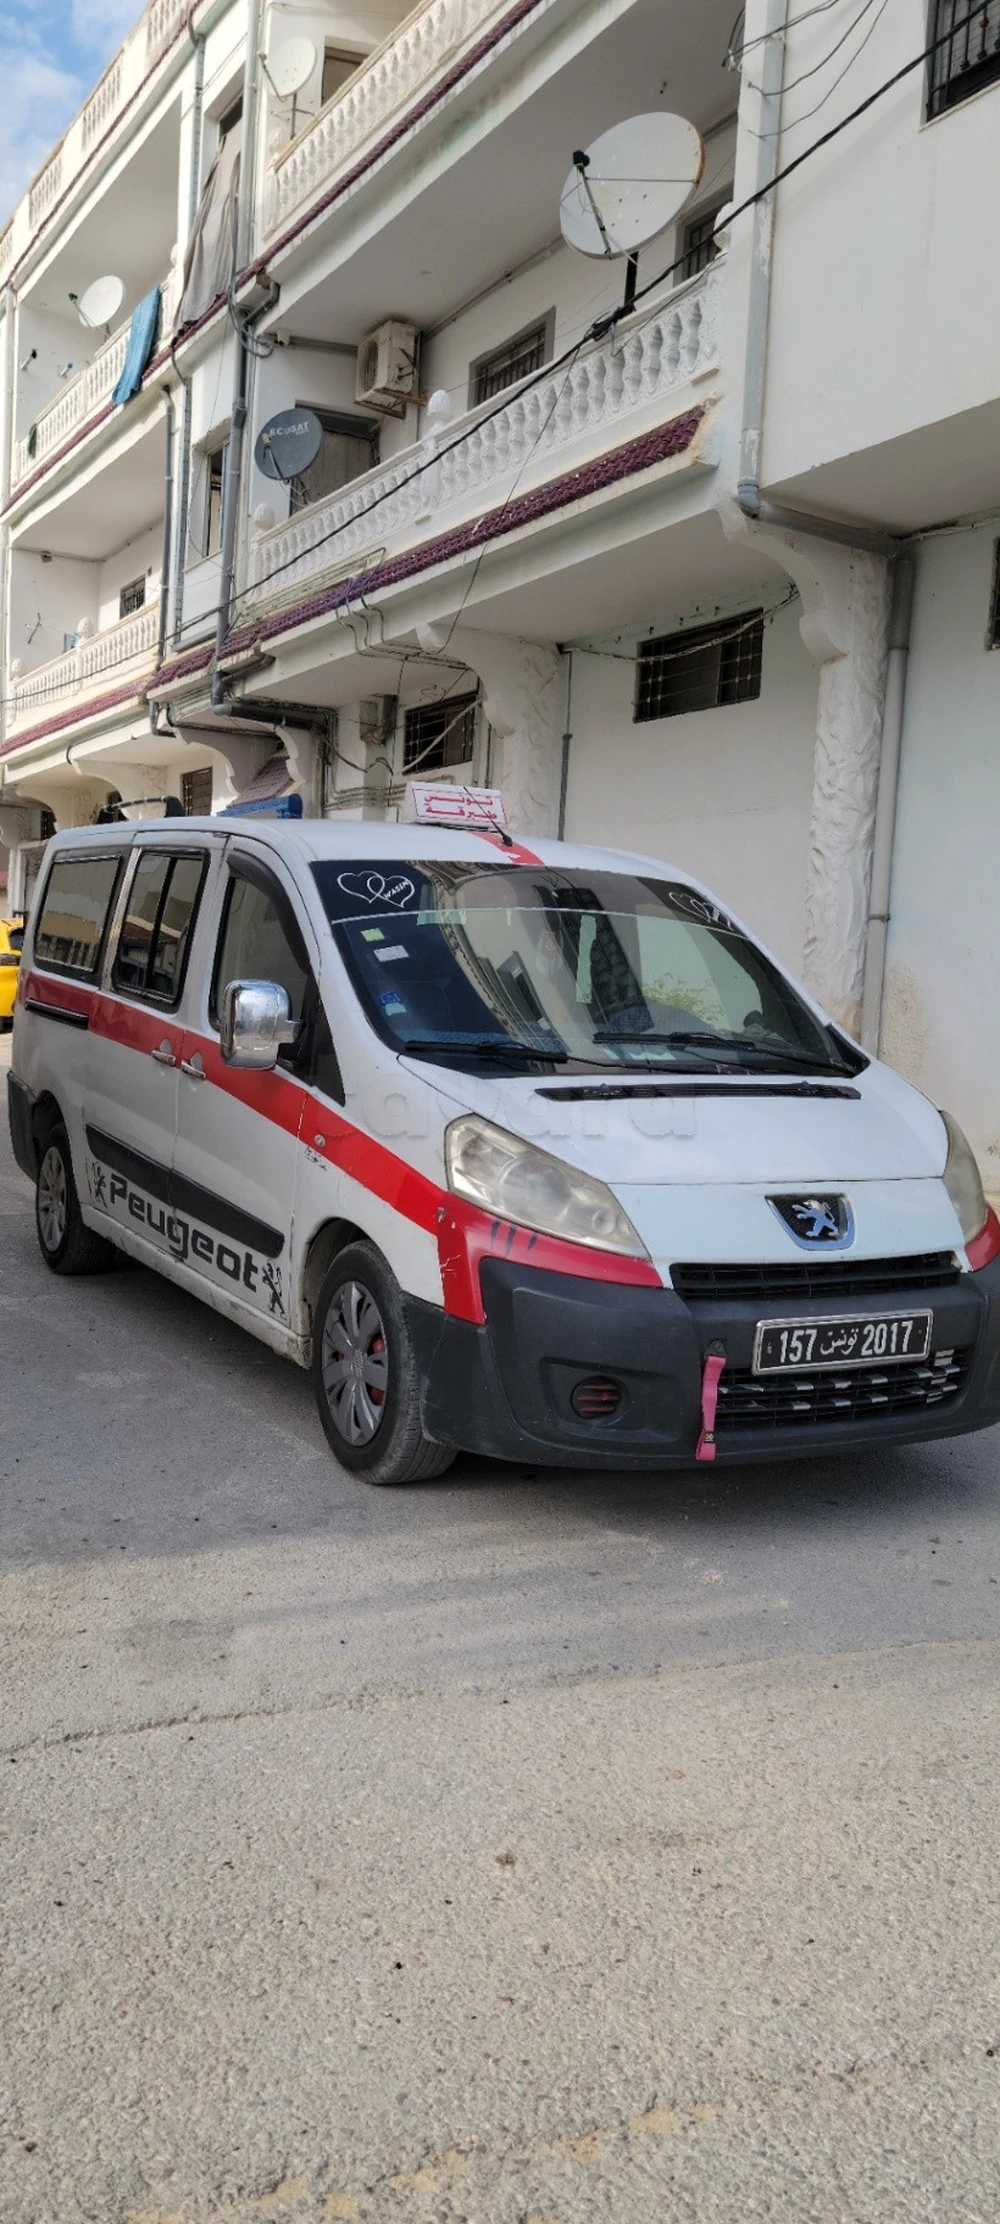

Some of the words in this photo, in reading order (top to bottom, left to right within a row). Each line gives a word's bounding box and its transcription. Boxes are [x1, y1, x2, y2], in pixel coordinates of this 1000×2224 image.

[422, 794, 493, 806] تونس
[110, 1173, 258, 1292] Peugeot
[780, 1329, 818, 1363] 157
[820, 1328, 859, 1355] تونس
[861, 1320, 913, 1356] 2017
